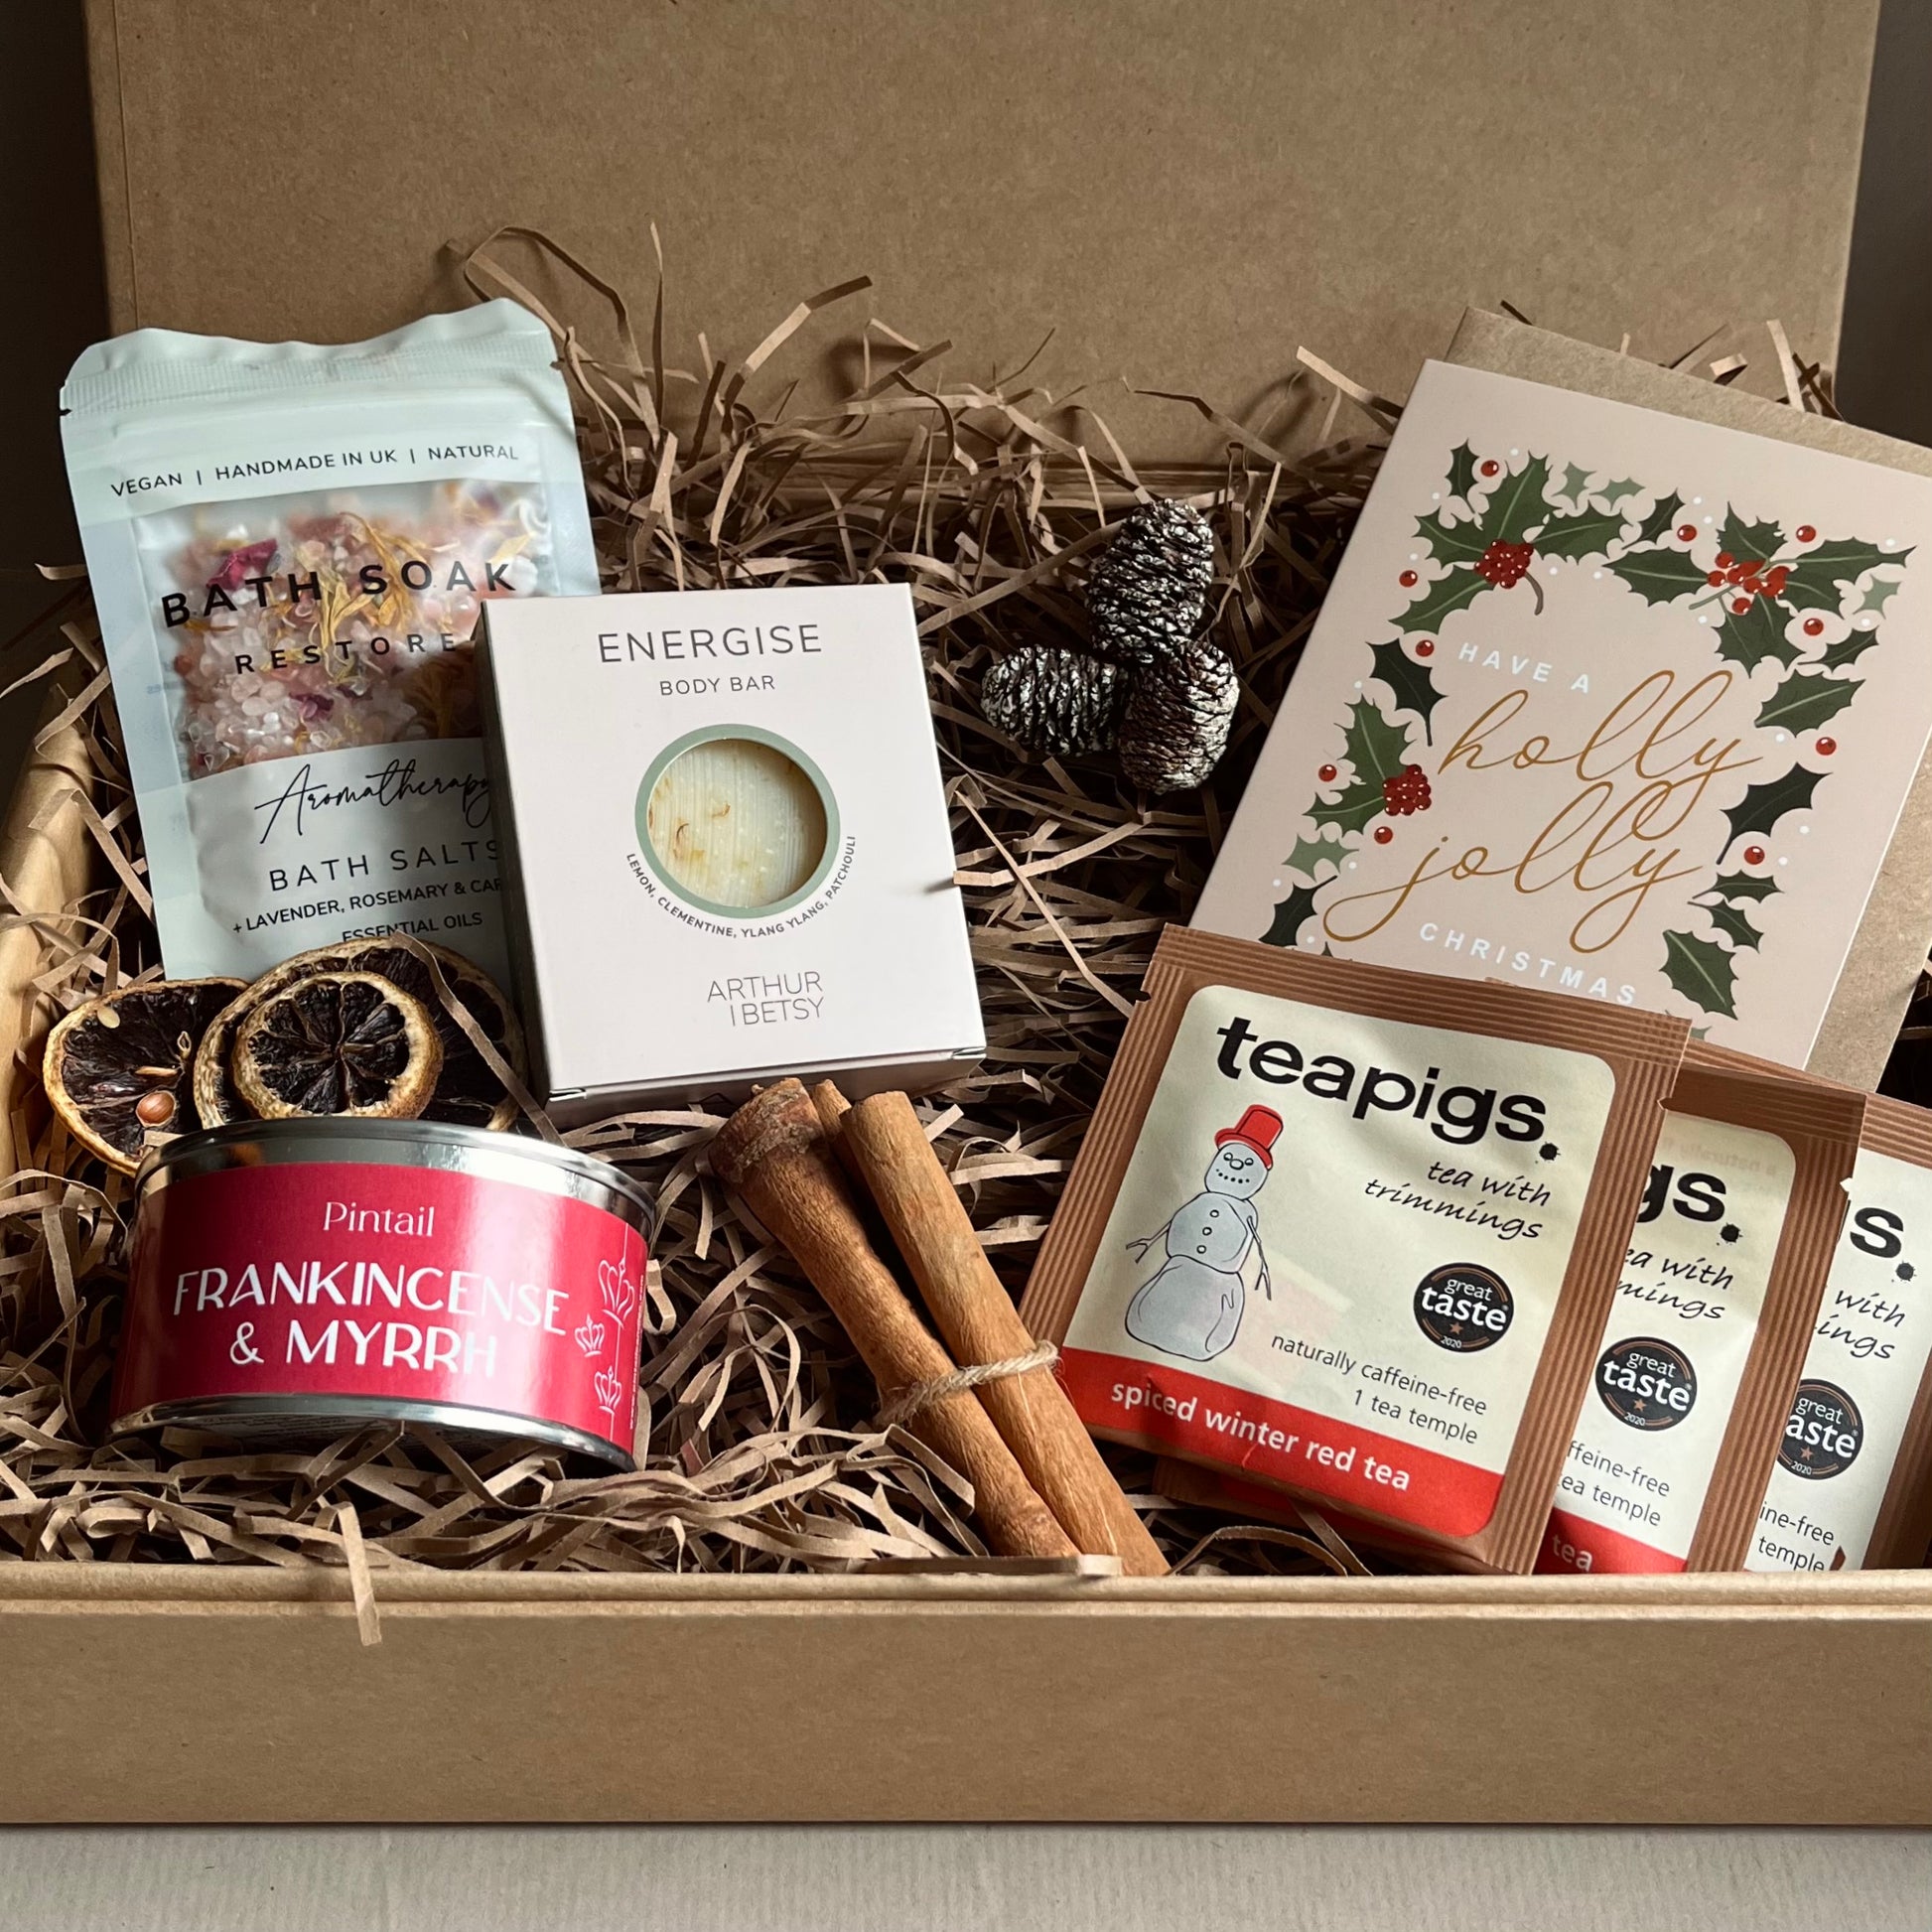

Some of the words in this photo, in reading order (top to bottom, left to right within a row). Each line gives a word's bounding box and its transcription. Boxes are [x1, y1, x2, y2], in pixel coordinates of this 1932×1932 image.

[111, 472, 183, 497] VEGAN
[215, 453, 336, 481] HANDMADE
[343, 451, 363, 467] IN
[370, 448, 397, 465] UK
[428, 445, 519, 462] NATURAL
[162, 571, 322, 627] BATH
[359, 560, 516, 595] SOAK
[235, 632, 457, 675] RESTORE
[598, 623, 822, 663] ENERGISE
[659, 677, 721, 696] BODY
[730, 675, 775, 692] BAR
[1457, 641, 1554, 683] HAVE
[1571, 673, 1590, 694] A
[1438, 669, 1764, 841] holly
[254, 759, 491, 844] Aromatherapy
[269, 854, 369, 892] BATH
[390, 840, 498, 871] SALTS
[626, 853, 656, 898] LEMON,
[657, 897, 737, 939] CLEMENTINE,
[741, 922, 785, 938] YLANG
[785, 900, 829, 929] YLANG,
[825, 836, 856, 899] PATCHOULI
[1322, 780, 1704, 953] jolly
[245, 899, 345, 931] LAVENDER,
[349, 883, 449, 910] ROSEMARY
[454, 881, 467, 895] &
[443, 911, 483, 929] OILS
[707, 970, 824, 1003] ARTHUR
[1419, 921, 1637, 1006] CHRISTMAS
[1216, 1016, 1562, 1164] teapigs.
[1427, 1161, 1472, 1187] tea
[1480, 1175, 1552, 1208] with
[323, 1200, 435, 1237] Pintail
[1364, 1178, 1544, 1241] trimmings
[1444, 1278, 1493, 1302] great
[1661, 1257, 1734, 1290] with
[173, 1260, 570, 1337] FRANKINCENSE
[1421, 1286, 1507, 1331] taste
[1835, 1290, 1905, 1328] with
[229, 1321, 265, 1366] &
[285, 1319, 496, 1379] MYRRH
[1440, 1335, 1462, 1349] 2020
[1815, 1313, 1896, 1359] ings
[1270, 1332, 1356, 1375] naturally
[1360, 1360, 1488, 1416] caffeine-free
[1603, 1360, 1690, 1412] taste
[1626, 1352, 1677, 1378] great
[1354, 1389, 1363, 1406] 1
[1371, 1396, 1402, 1420] tea
[1408, 1405, 1478, 1445] temple
[1624, 1412, 1646, 1427] 2020
[1795, 1397, 1844, 1425] great
[1111, 1381, 1197, 1423] spiced
[1204, 1406, 1300, 1454] winter
[1305, 1441, 1356, 1472] red
[1363, 1454, 1411, 1491] tea
[1790, 1460, 1813, 1475] 2020
[1557, 1475, 1586, 1496] ea
[1592, 1484, 1661, 1526] temple
[1552, 1534, 1593, 1573] tea
[1758, 1536, 1825, 1571] temple
